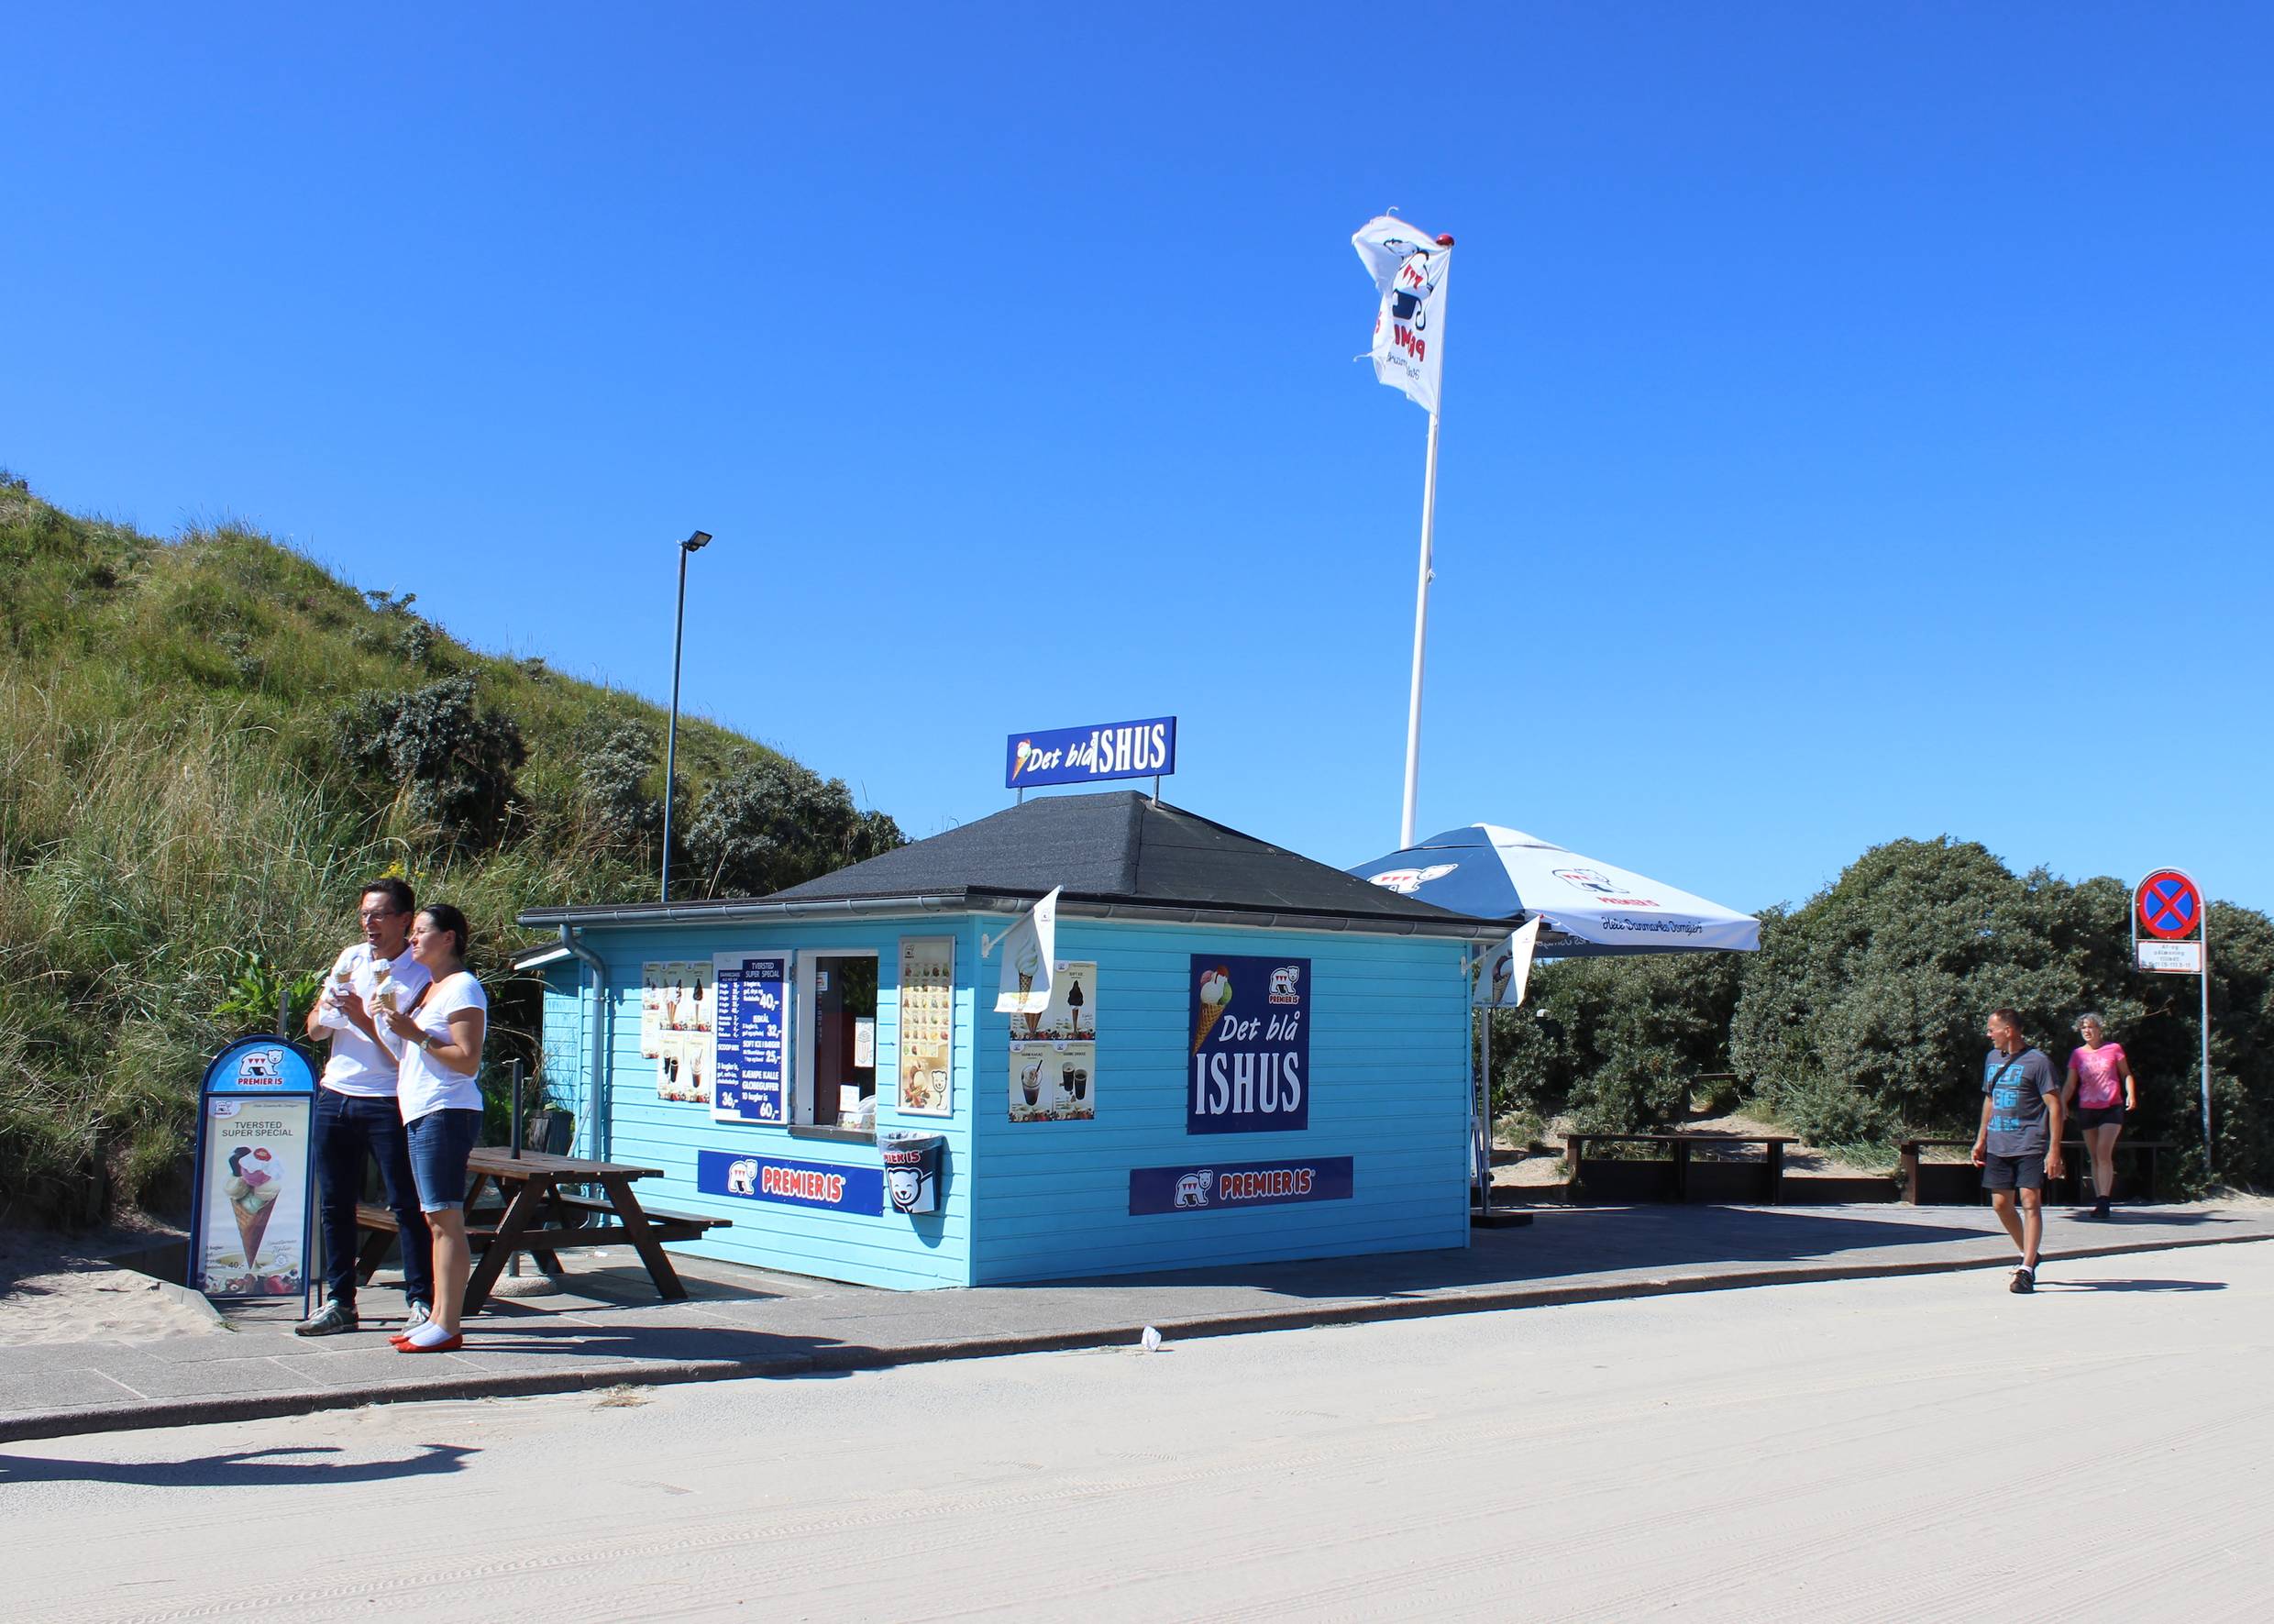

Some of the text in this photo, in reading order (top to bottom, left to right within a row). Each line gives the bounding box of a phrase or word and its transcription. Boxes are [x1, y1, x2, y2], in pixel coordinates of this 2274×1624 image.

[1027, 724, 1166, 774] Det blå ISHUS
[1219, 1011, 1300, 1042] Det blå
[743, 1040, 754, 1048] SOFT
[766, 1050, 781, 1065] 25,-
[763, 1071, 778, 1080] KALLE
[1195, 1052, 1301, 1115] ISHUS
[722, 1091, 739, 1109] 36,-
[759, 1102, 779, 1120] 60,-
[222, 1129, 253, 1137] SUPER
[906, 1150, 921, 1164] IS
[762, 1166, 843, 1203] PREMIER IS
[1220, 1168, 1311, 1201] PREMIER IS
